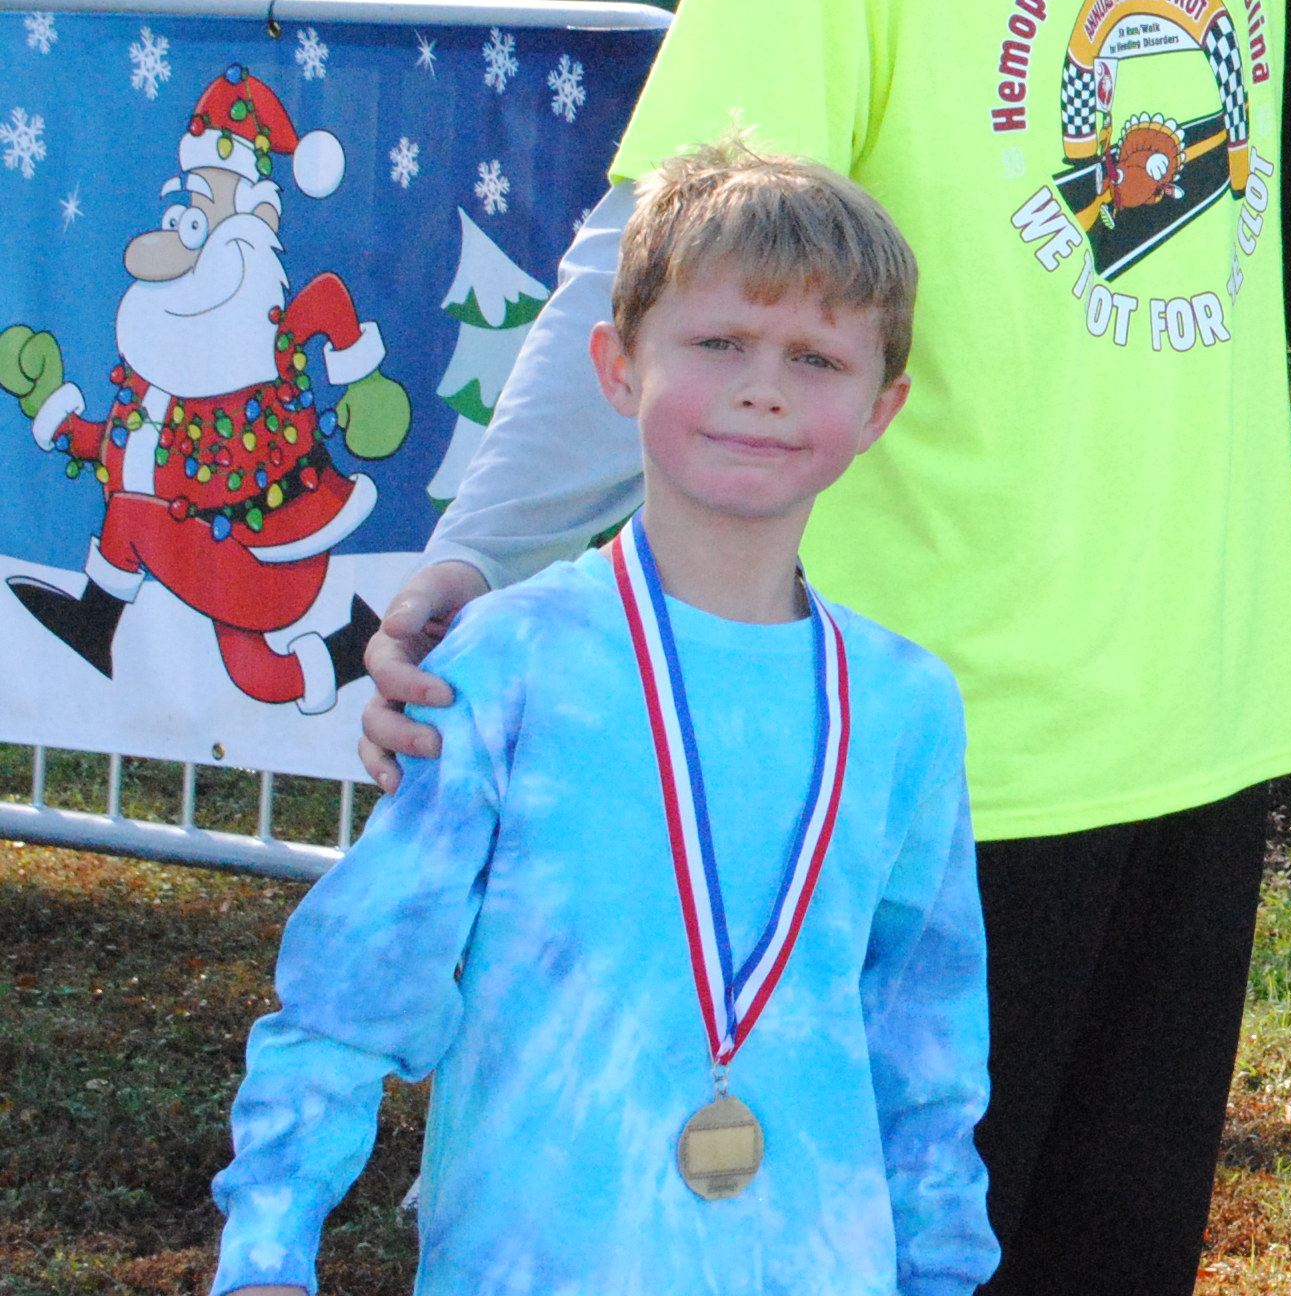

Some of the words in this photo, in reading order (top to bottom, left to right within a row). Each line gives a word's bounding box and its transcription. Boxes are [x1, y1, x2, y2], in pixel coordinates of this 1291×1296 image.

[1143, 35, 1179, 47] Disorders
[1010, 185, 1083, 272] WE
[1072, 248, 1138, 347] TOT
[1149, 291, 1231, 352] FOR
[1237, 145, 1274, 256] CLOT
